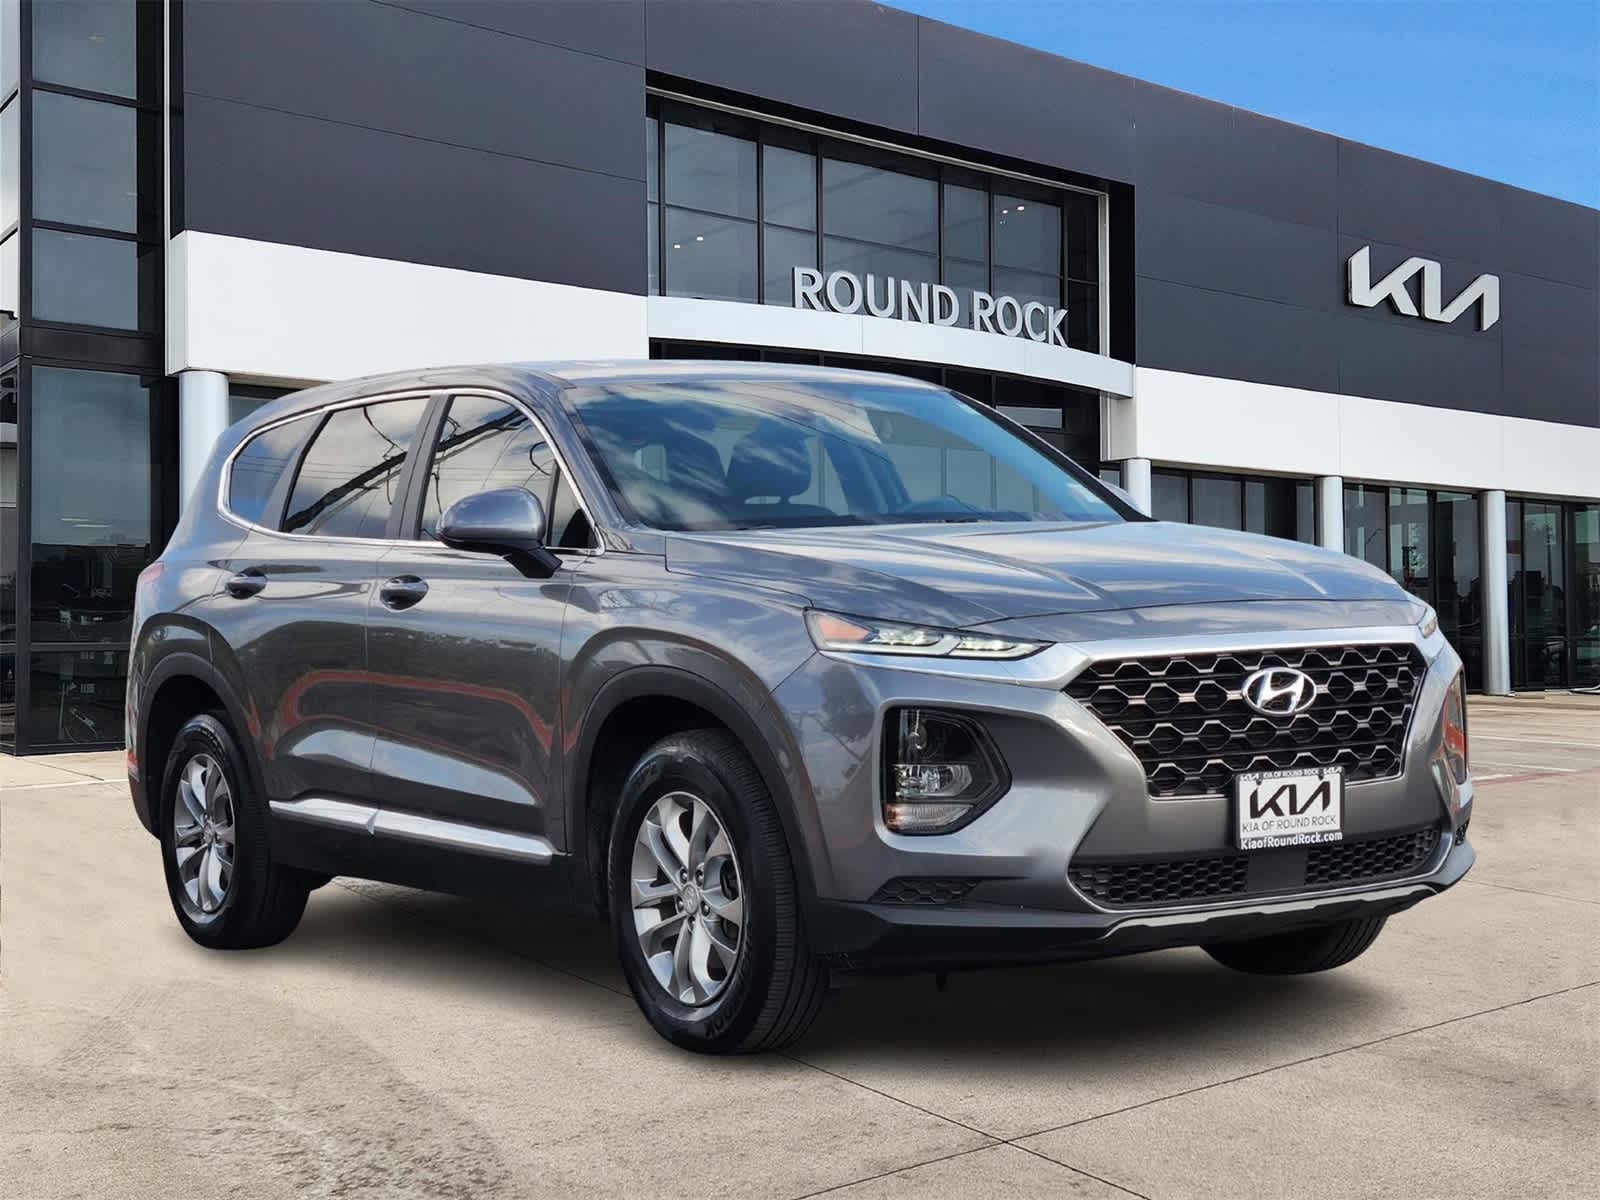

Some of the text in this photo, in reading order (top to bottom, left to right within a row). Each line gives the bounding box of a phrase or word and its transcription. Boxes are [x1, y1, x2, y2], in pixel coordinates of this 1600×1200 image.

[793, 266, 1069, 348] ROUND ROCK
[1347, 245, 1500, 331] KIA
[1249, 781, 1330, 819] KIA
[1240, 831, 1343, 850] KiaofRoundRock.com
[1242, 815, 1337, 833] KIA OF ROUND ROCK
